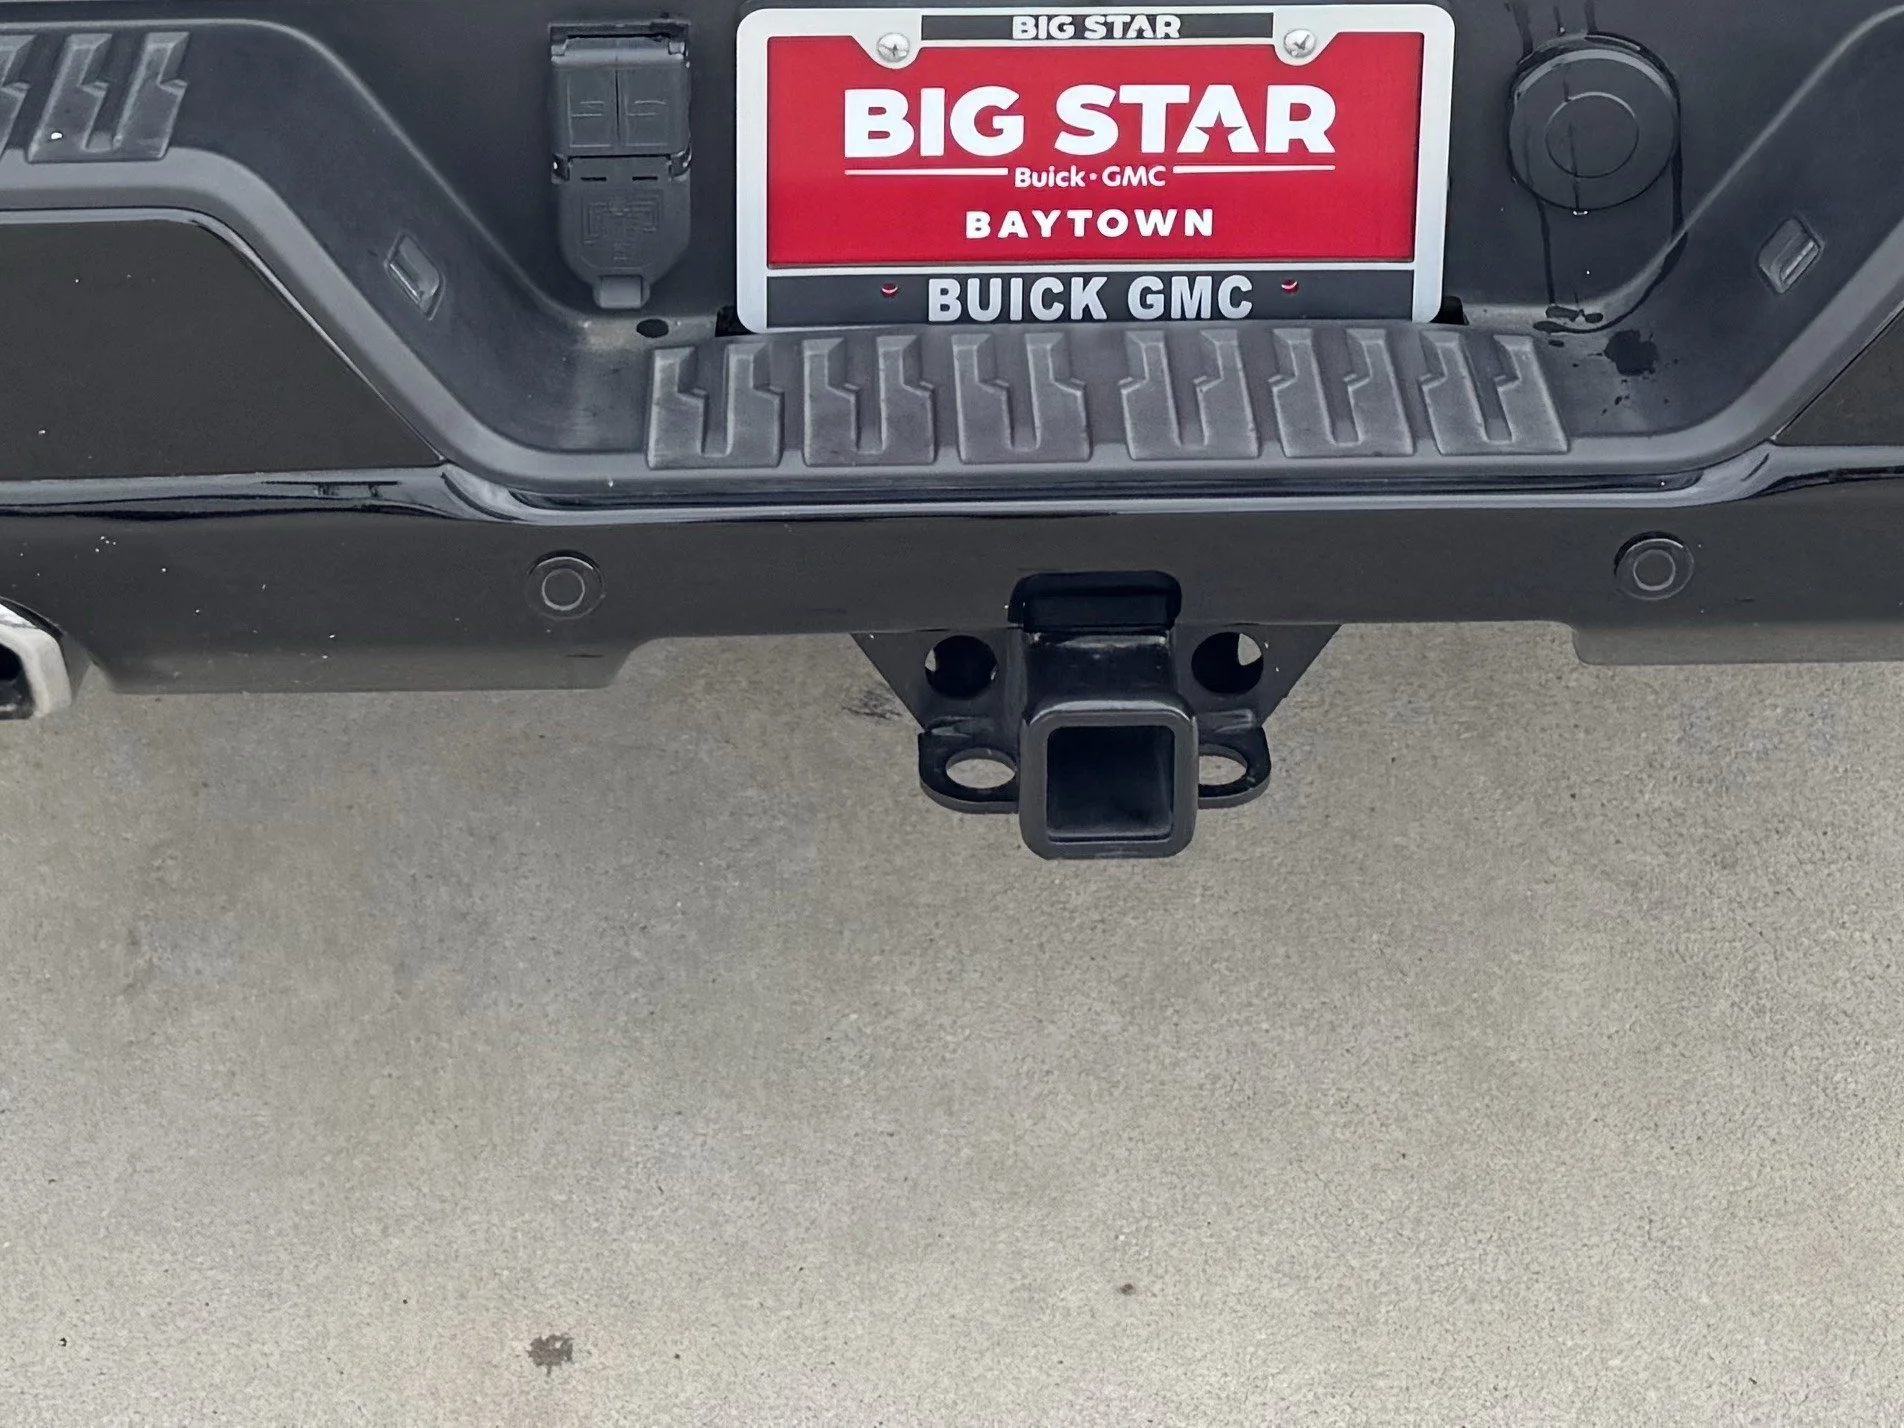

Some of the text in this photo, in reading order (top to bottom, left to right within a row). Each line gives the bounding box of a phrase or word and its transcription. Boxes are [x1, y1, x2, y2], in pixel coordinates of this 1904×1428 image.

[1013, 13, 1183, 40] BIG STAR
[844, 83, 1337, 158] BIG STAR
[1014, 164, 1167, 189] Buick GMC
[966, 208, 1214, 239] BAYTOWN
[927, 274, 1254, 323] BUICK GMC
